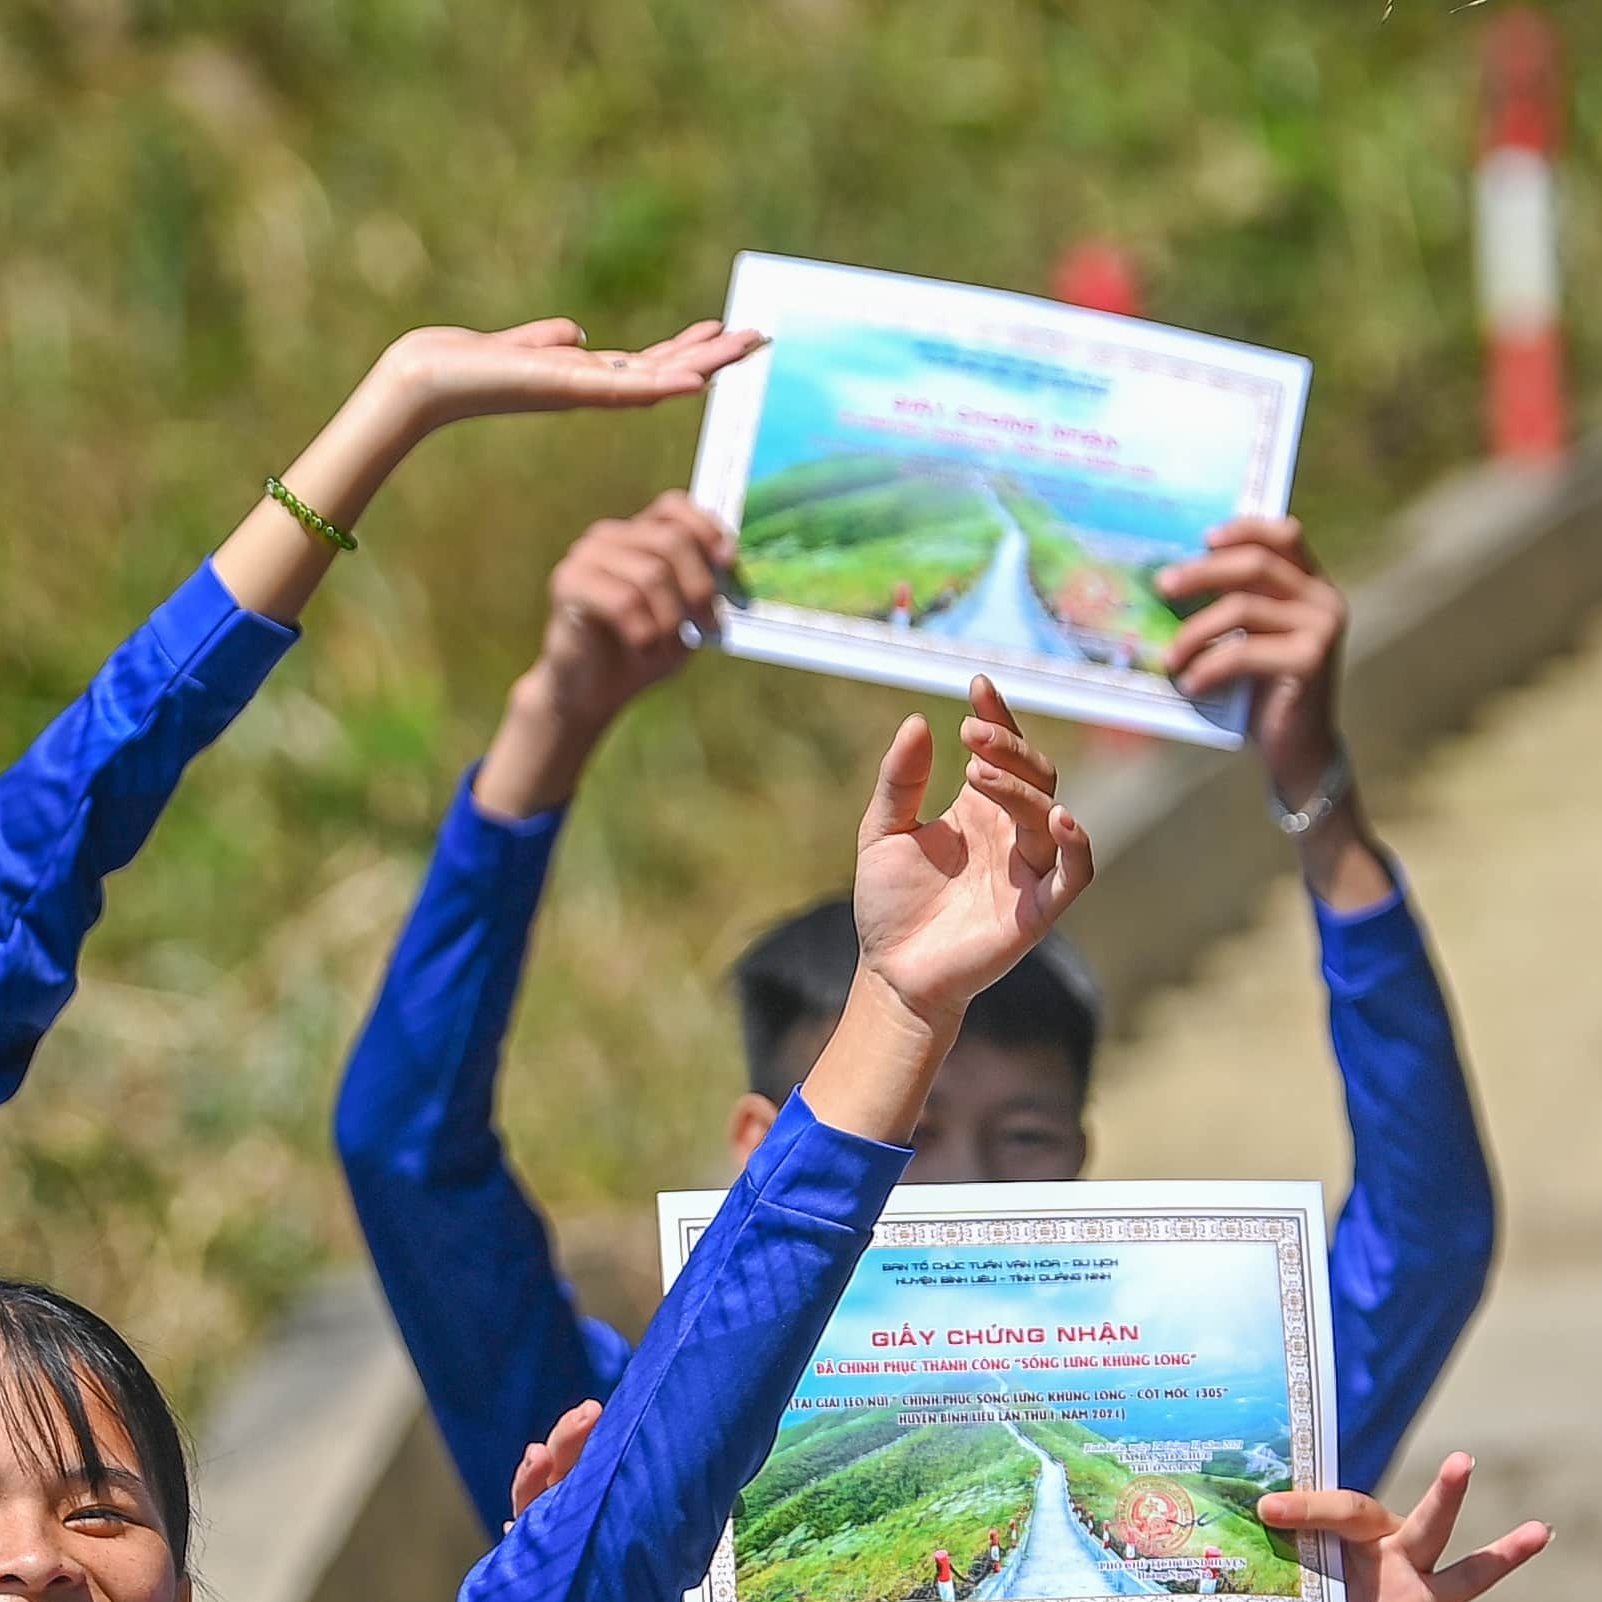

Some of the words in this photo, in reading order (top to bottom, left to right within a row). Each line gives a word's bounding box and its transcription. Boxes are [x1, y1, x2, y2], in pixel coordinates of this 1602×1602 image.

[871, 1322, 936, 1347] GIẤY
[948, 1323, 1046, 1346] CHỨNG
[1057, 1321, 1139, 1345] NHẬN
[838, 1361, 880, 1374] CHINH
[1094, 1389, 1126, 1400] LONG
